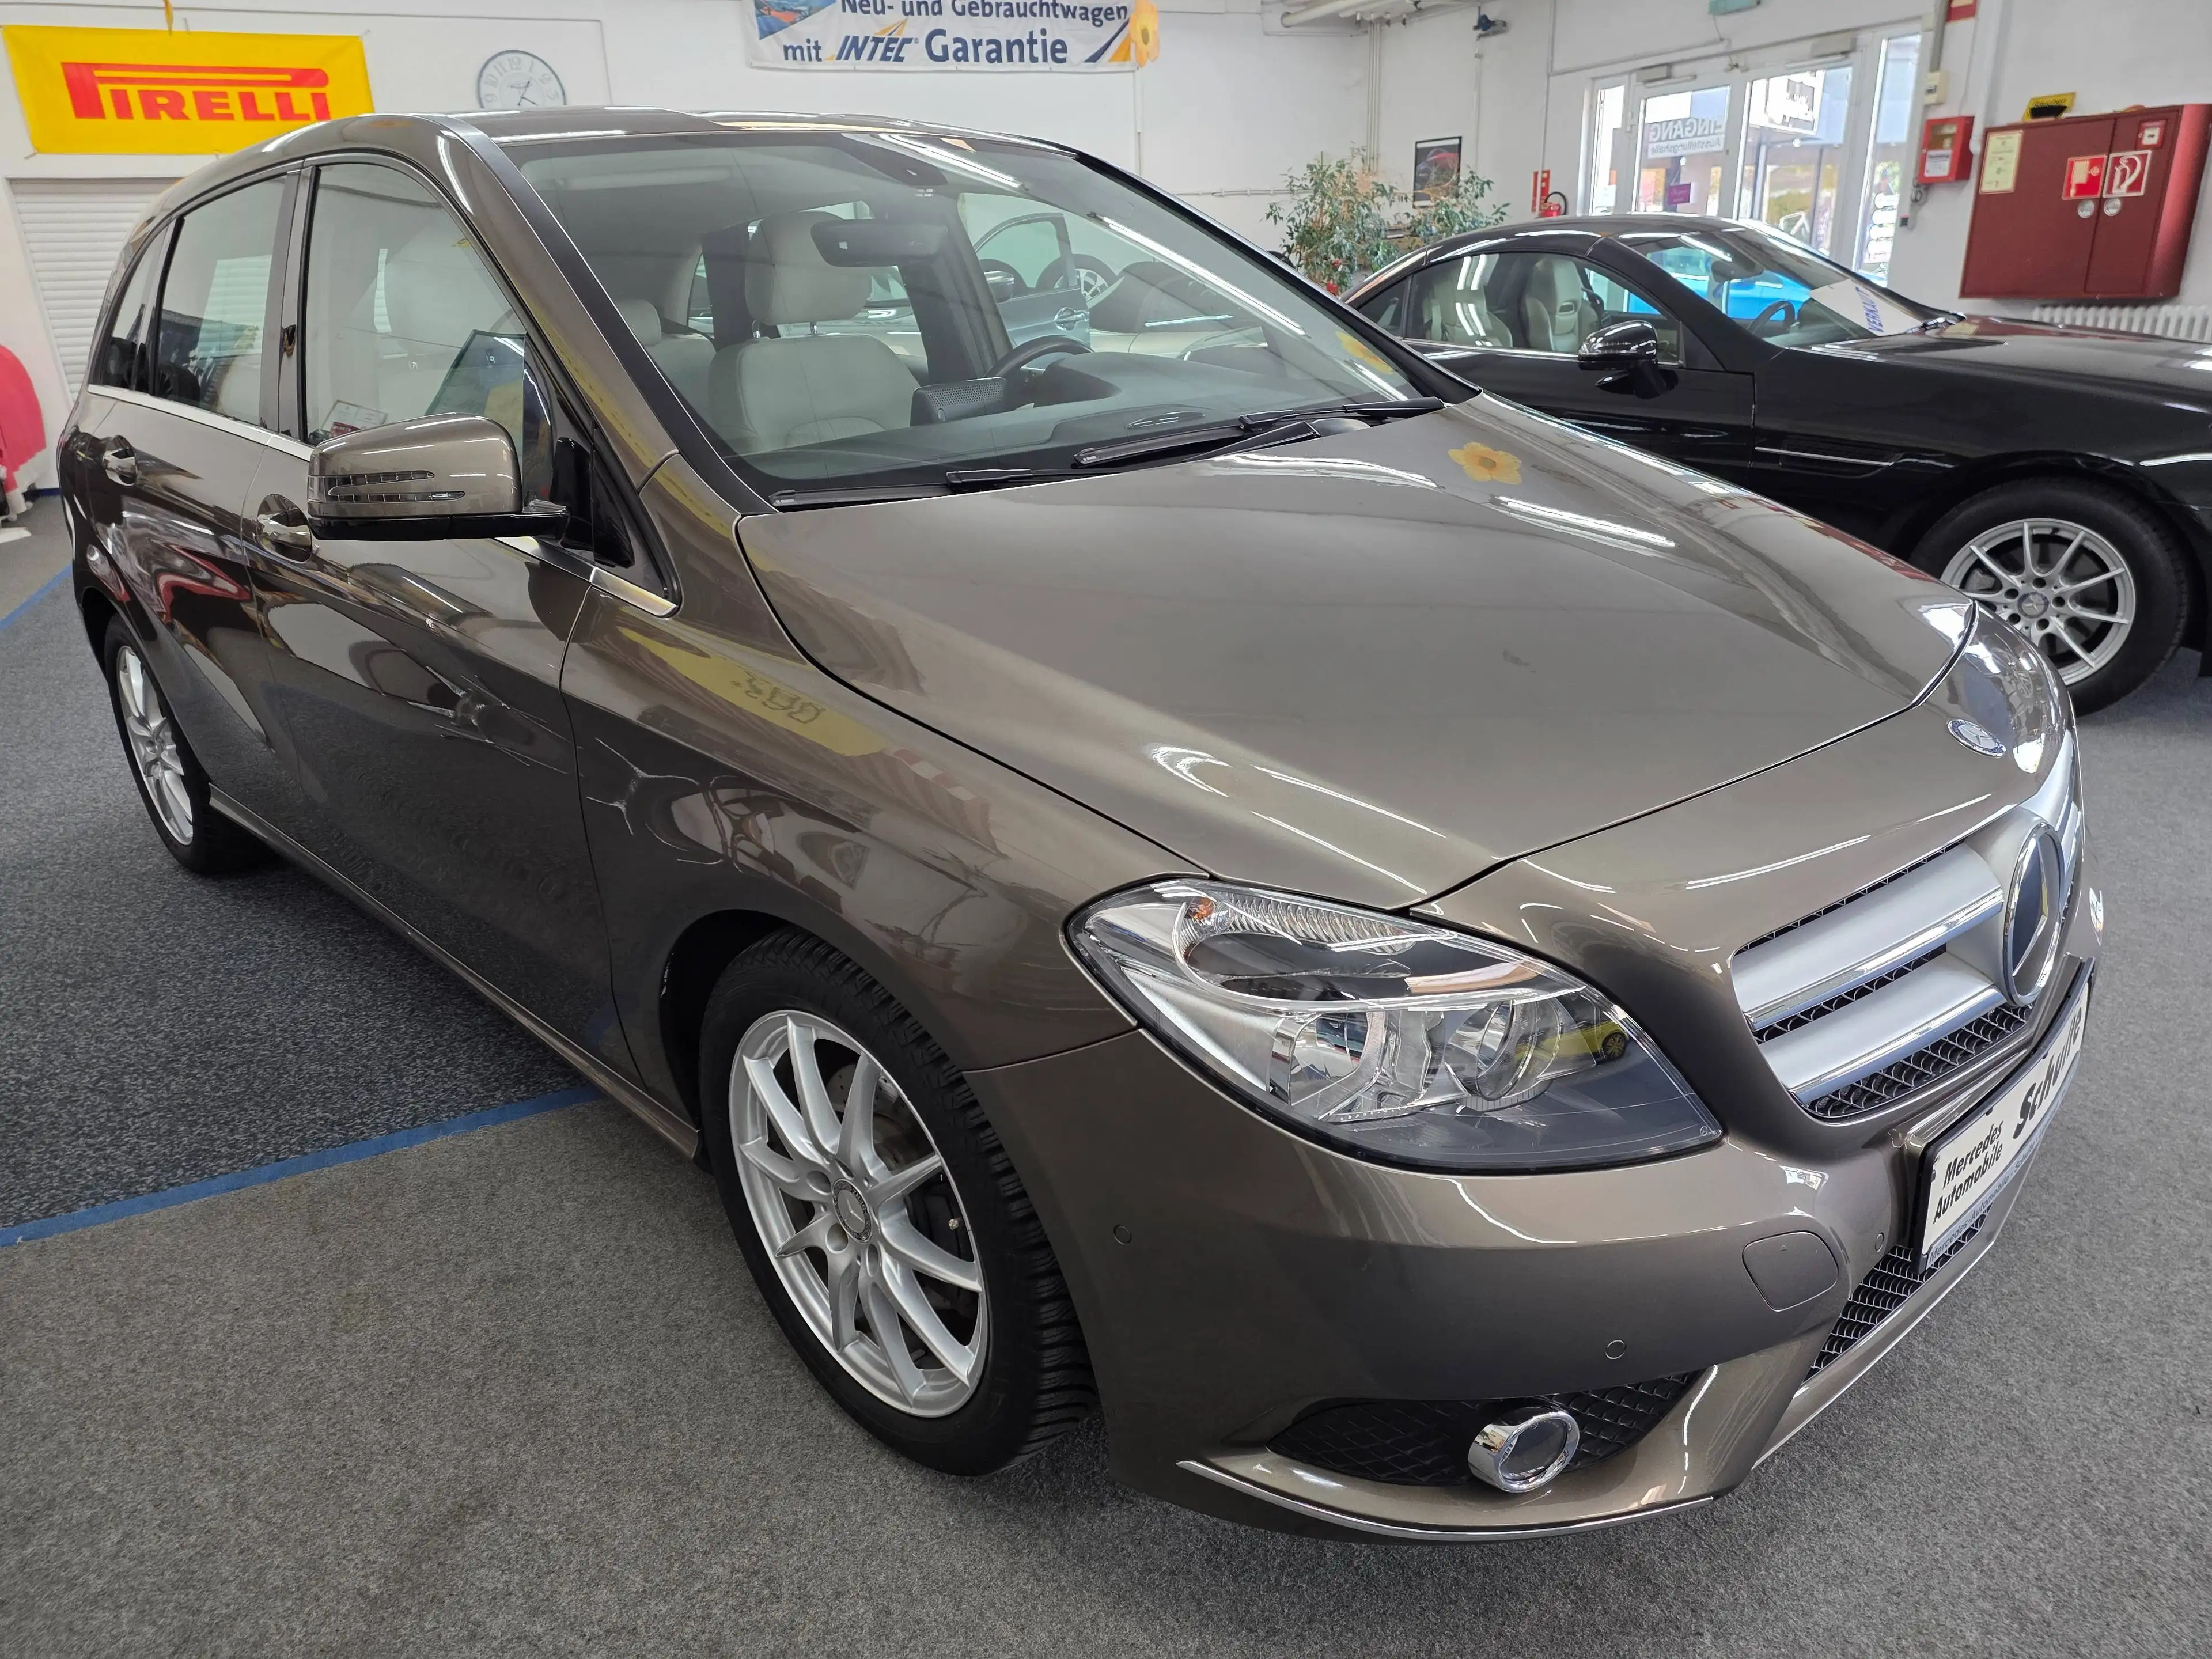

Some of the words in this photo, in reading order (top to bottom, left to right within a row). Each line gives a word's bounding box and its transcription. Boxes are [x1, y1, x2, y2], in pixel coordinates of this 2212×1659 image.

[842, 0, 894, 15] Neu-
[902, 0, 942, 16] und
[951, 0, 1127, 27] Gebrauchtwagen
[783, 38, 823, 62] mit
[924, 28, 1068, 64] Garantie
[61, 62, 332, 121] PIRELLI
[1933, 1141, 2003, 1225] Automobile
[1942, 1120, 2004, 1190] Mercedes
